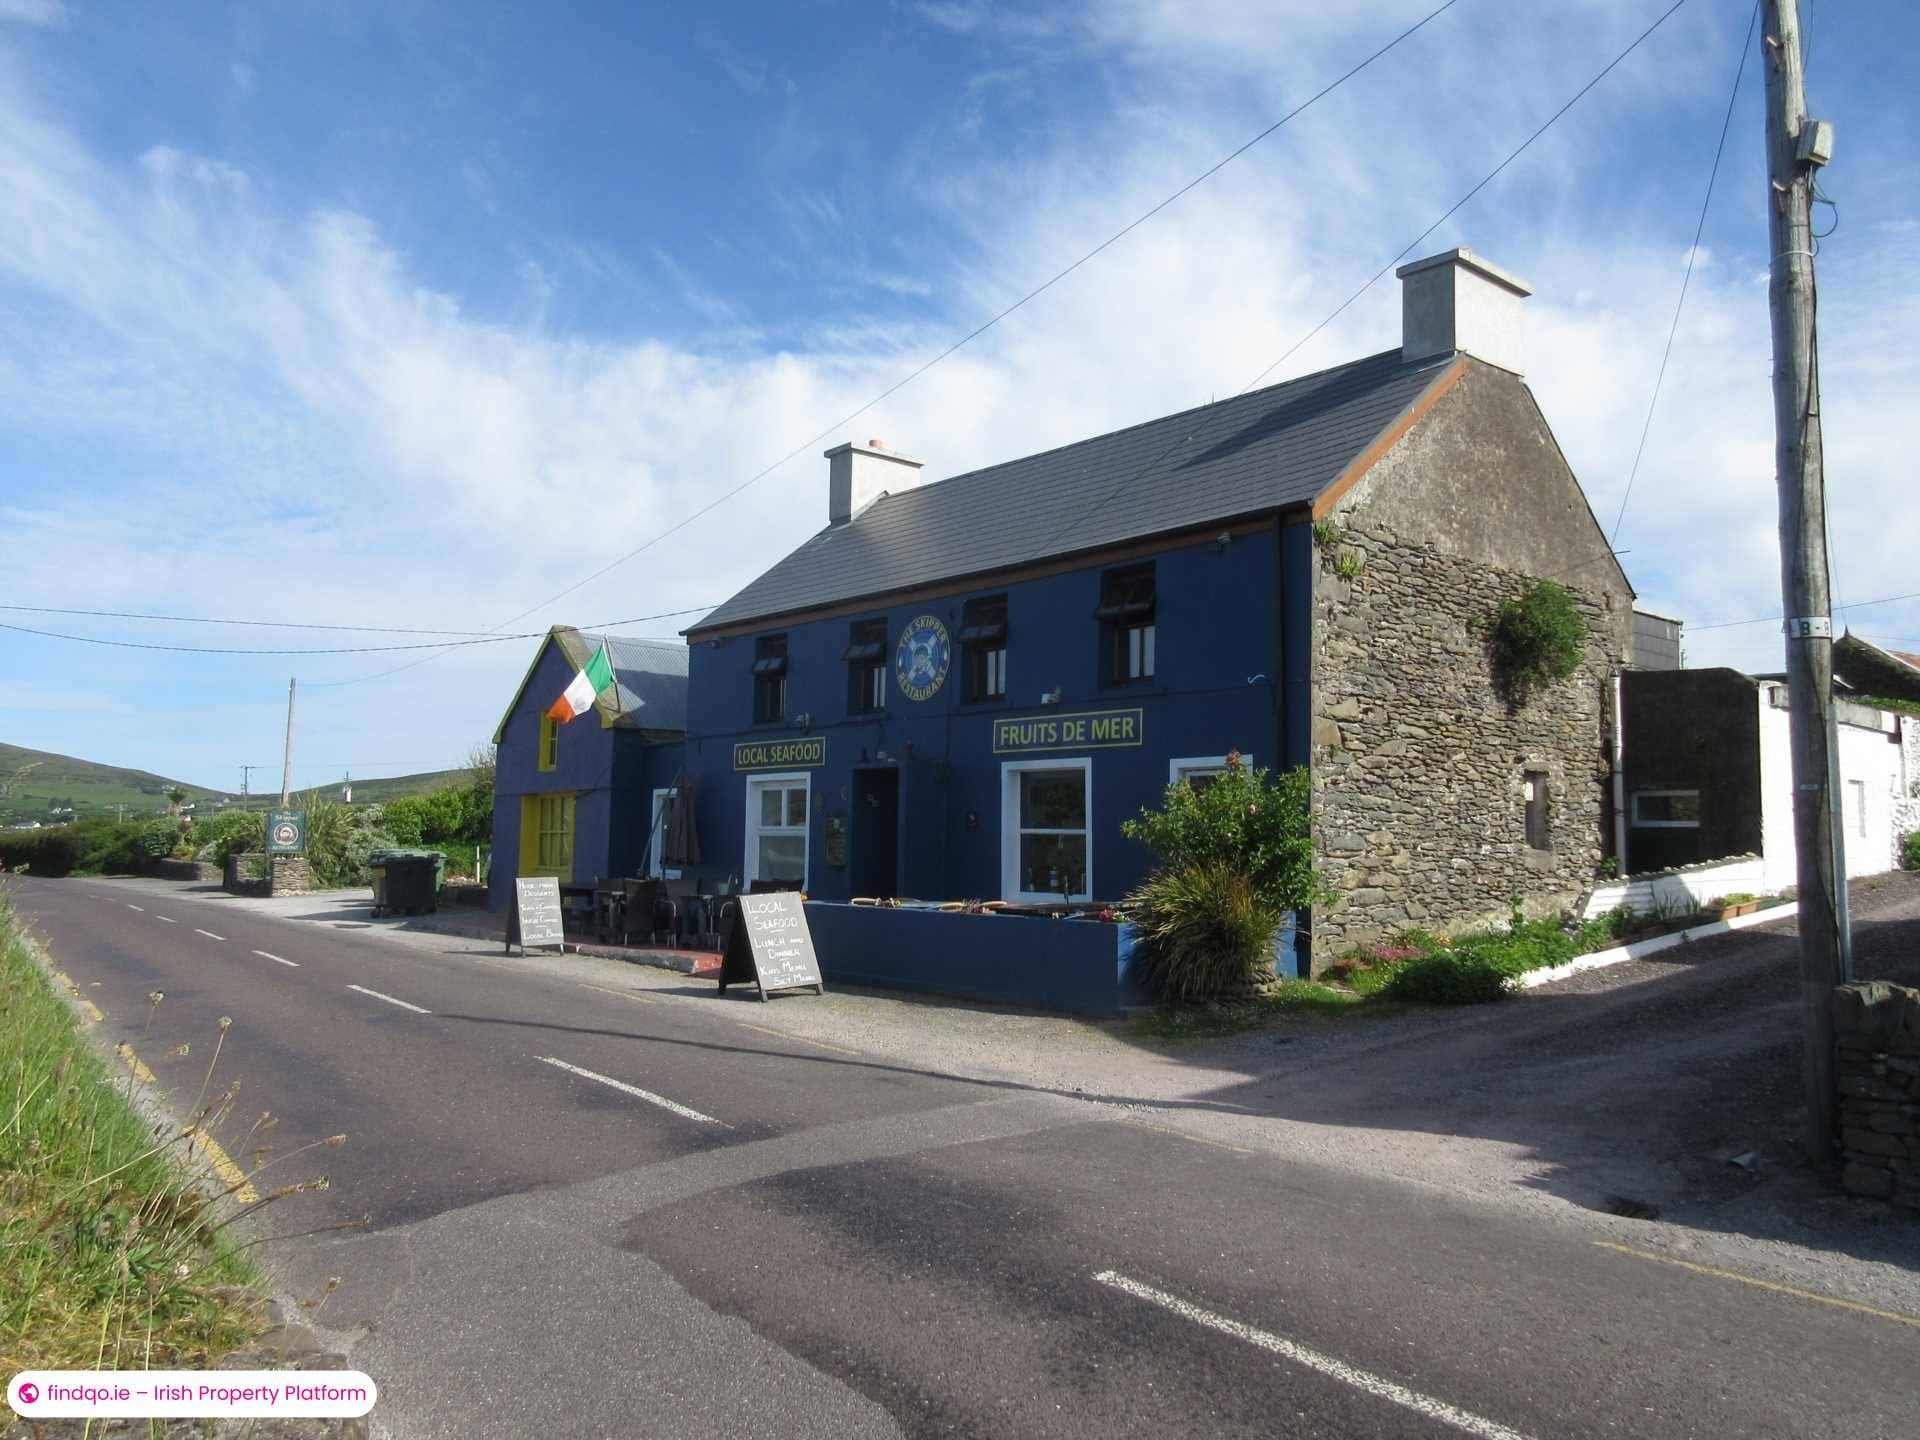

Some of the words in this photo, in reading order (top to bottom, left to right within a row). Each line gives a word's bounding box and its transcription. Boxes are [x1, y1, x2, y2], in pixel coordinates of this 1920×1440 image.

[1000, 722, 1057, 746] FRUITS
[1062, 720, 1086, 742] DE
[1091, 716, 1134, 740] MER
[738, 747, 768, 765] LOCAL
[770, 743, 820, 762] SEAFOOD
[746, 899, 787, 914] LOCAL
[753, 916, 798, 930] SEAFOOD
[754, 936, 785, 949] LUNCH
